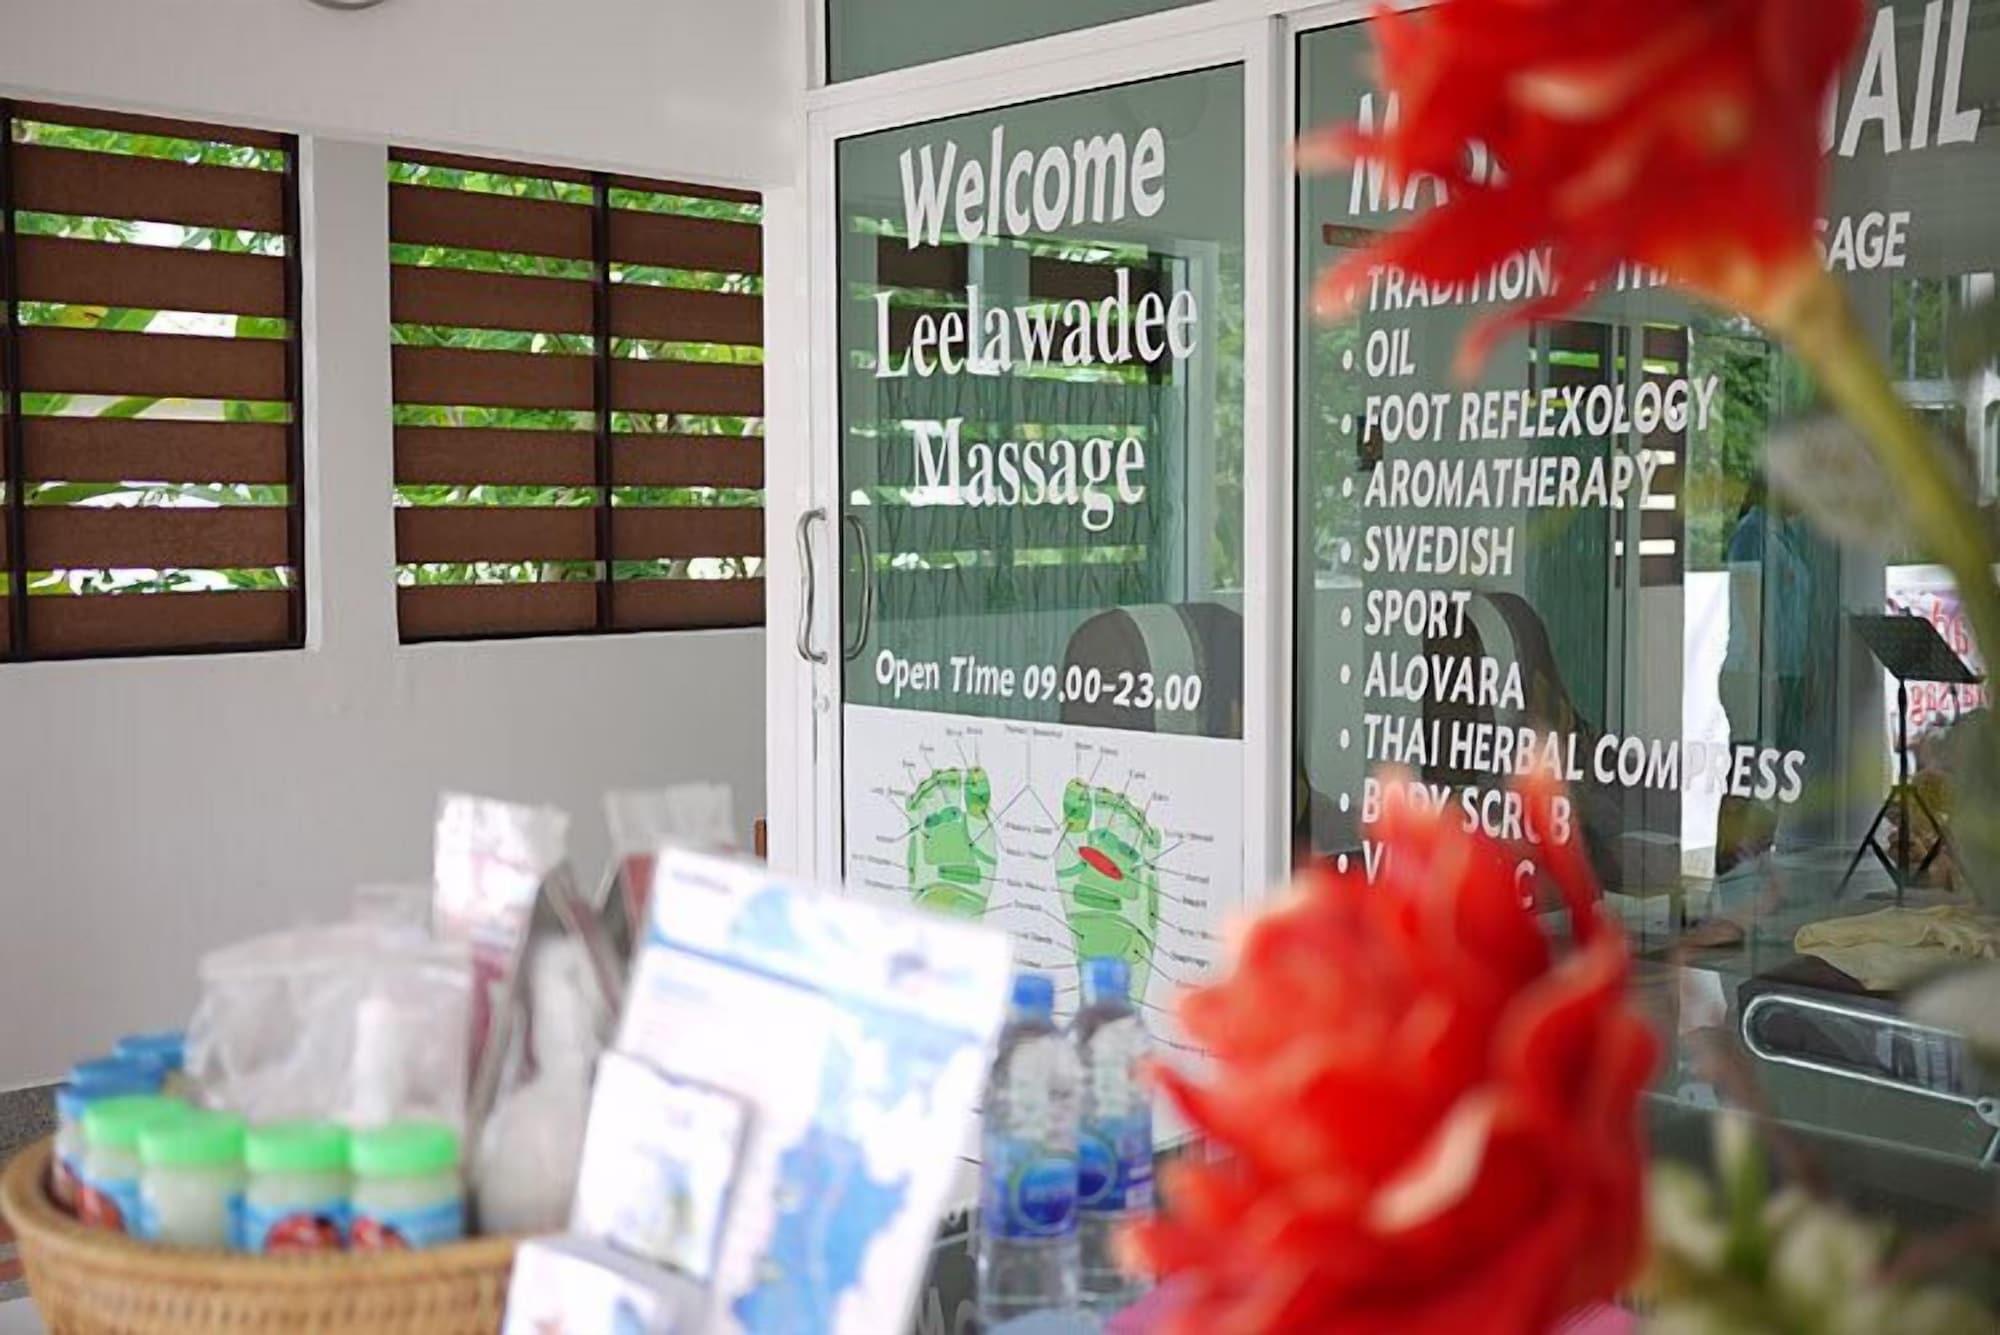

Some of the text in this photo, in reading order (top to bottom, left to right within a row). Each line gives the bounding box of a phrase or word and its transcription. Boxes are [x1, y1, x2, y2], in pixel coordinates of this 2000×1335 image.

[899, 126, 1165, 250] Welcome
[1367, 246, 1596, 312] TRADIION
[874, 267, 1198, 379] Leelawadee
[1366, 329, 1415, 377] OIL
[1363, 375, 1718, 444] FOOT REFLEXOLOGY
[901, 417, 1146, 531] Massage
[1364, 454, 1657, 508] AROMATHERAPY
[1363, 525, 1514, 576] SWEDISH
[1363, 590, 1471, 639] SPORT
[875, 649, 940, 698] Open
[1022, 664, 1202, 711] 09.00-23.00
[1364, 651, 1525, 710] ALOVARA
[1364, 714, 1805, 802] THAI HERBAL COMPRESS
